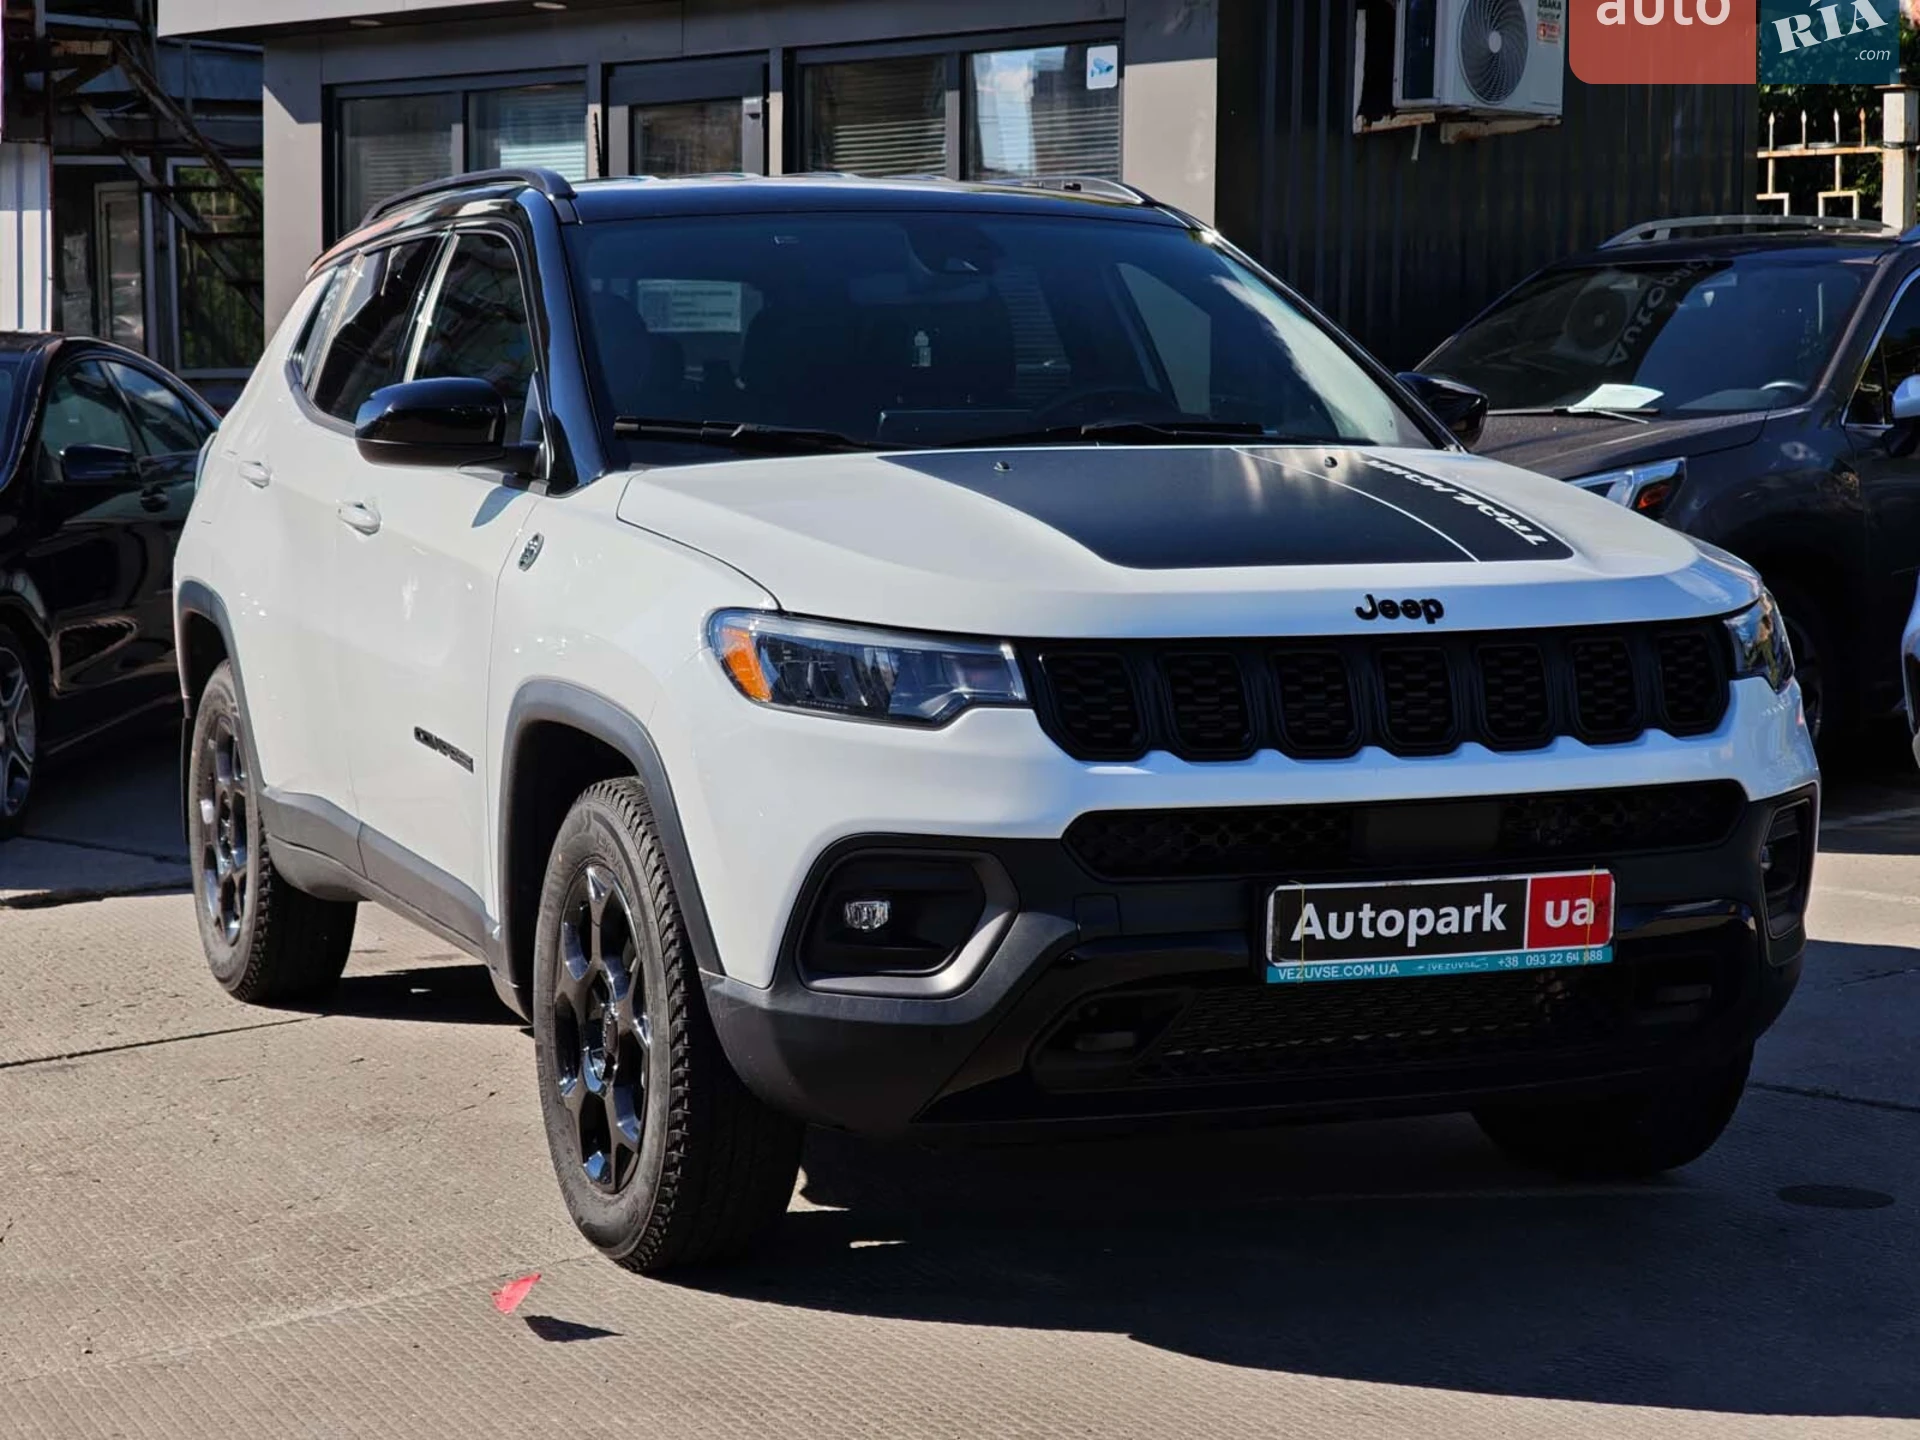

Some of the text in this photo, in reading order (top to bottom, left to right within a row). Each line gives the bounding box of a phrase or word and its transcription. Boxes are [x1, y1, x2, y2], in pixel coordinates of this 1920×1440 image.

[1355, 593, 1445, 624] Jeep
[1290, 892, 1507, 948] Autopark
[1544, 897, 1595, 928] ua
[1278, 963, 1400, 981] VEZUVSE.COM.UA
[1498, 955, 1519, 968] +38
[1526, 954, 1546, 966] 093
[1549, 953, 1563, 965] 22
[1566, 952, 1579, 963] 64
